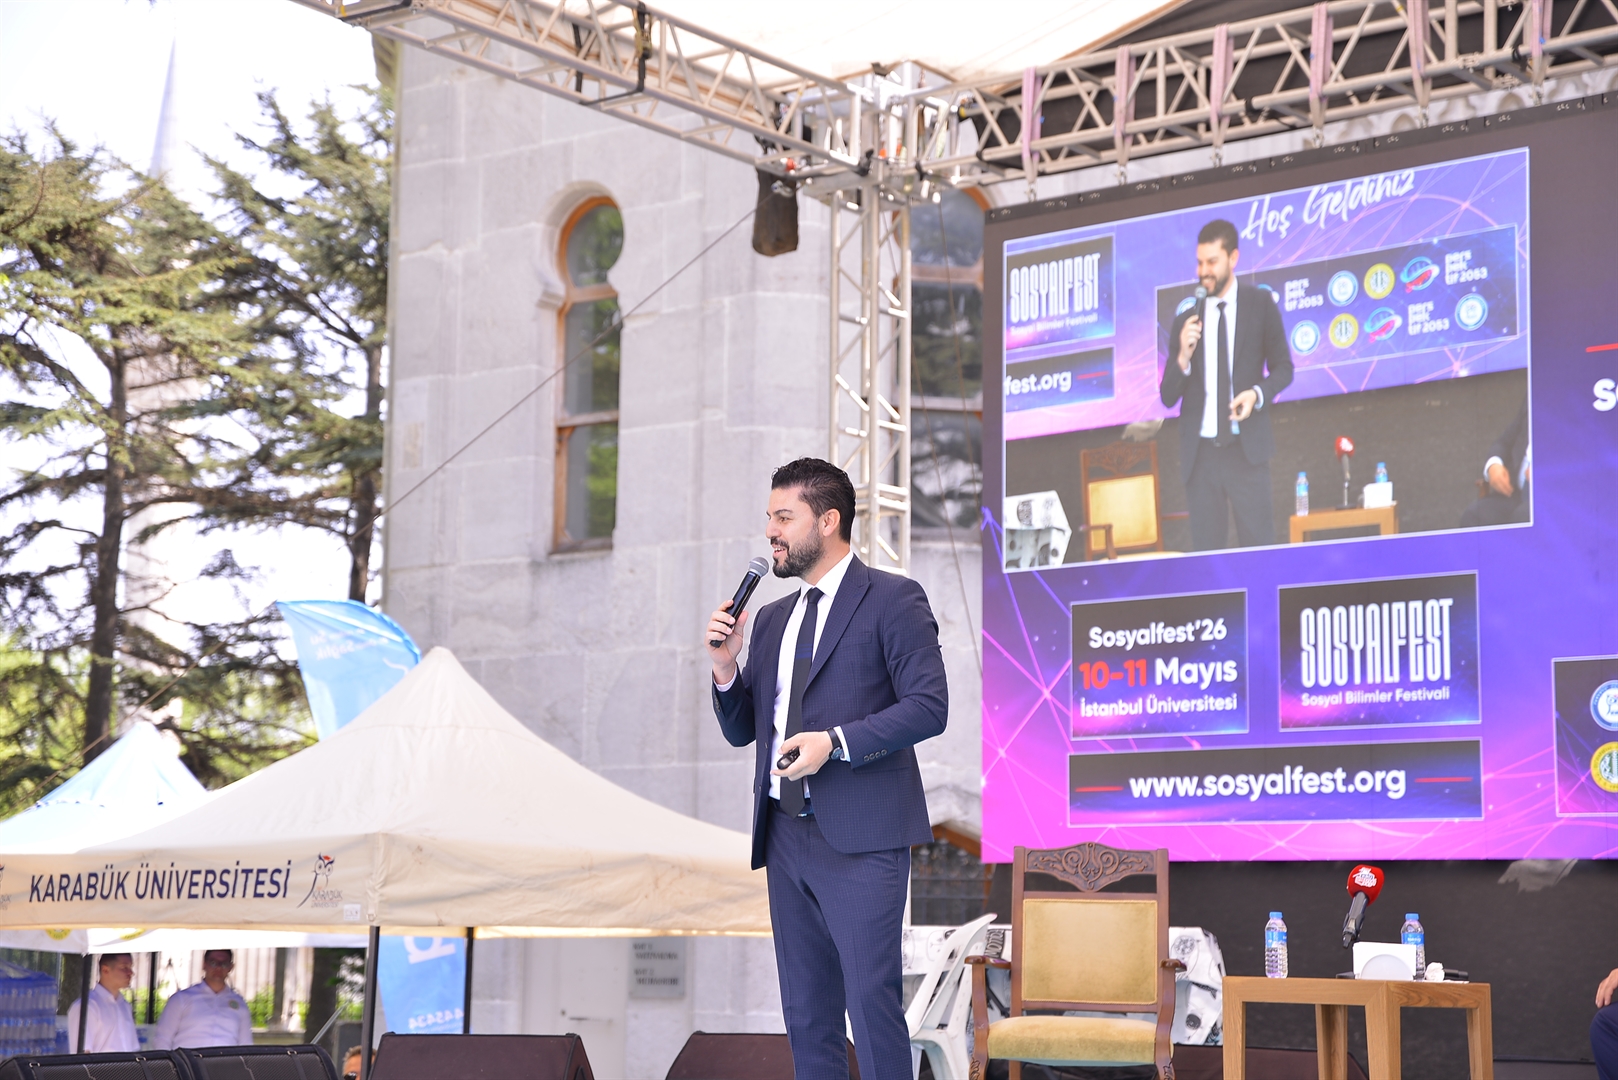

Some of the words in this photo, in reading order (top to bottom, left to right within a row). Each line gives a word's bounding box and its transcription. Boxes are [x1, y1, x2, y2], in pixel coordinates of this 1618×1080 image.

[1241, 195, 1294, 247] Hoş
[1303, 169, 1415, 229] Geldiniz
[1010, 253, 1101, 324] SOSYALFEST
[1004, 371, 1072, 397] fest.org
[1089, 618, 1227, 651] Sosyalfest'26
[1300, 598, 1453, 688] SOSYALFEST
[1079, 658, 1147, 690] 10-11
[1155, 657, 1238, 690] Mayıs
[1080, 697, 1143, 717] İstanbul
[1146, 693, 1238, 714] Üniversitesi
[1301, 692, 1342, 708] Sosyal
[1345, 689, 1393, 705] Bilimler
[1395, 686, 1450, 702] Festivali
[1129, 765, 1406, 802] www.sosyalfest.org
[29, 864, 130, 903] KARABÜK
[135, 860, 292, 900] ÜNİVERSİTESİ
